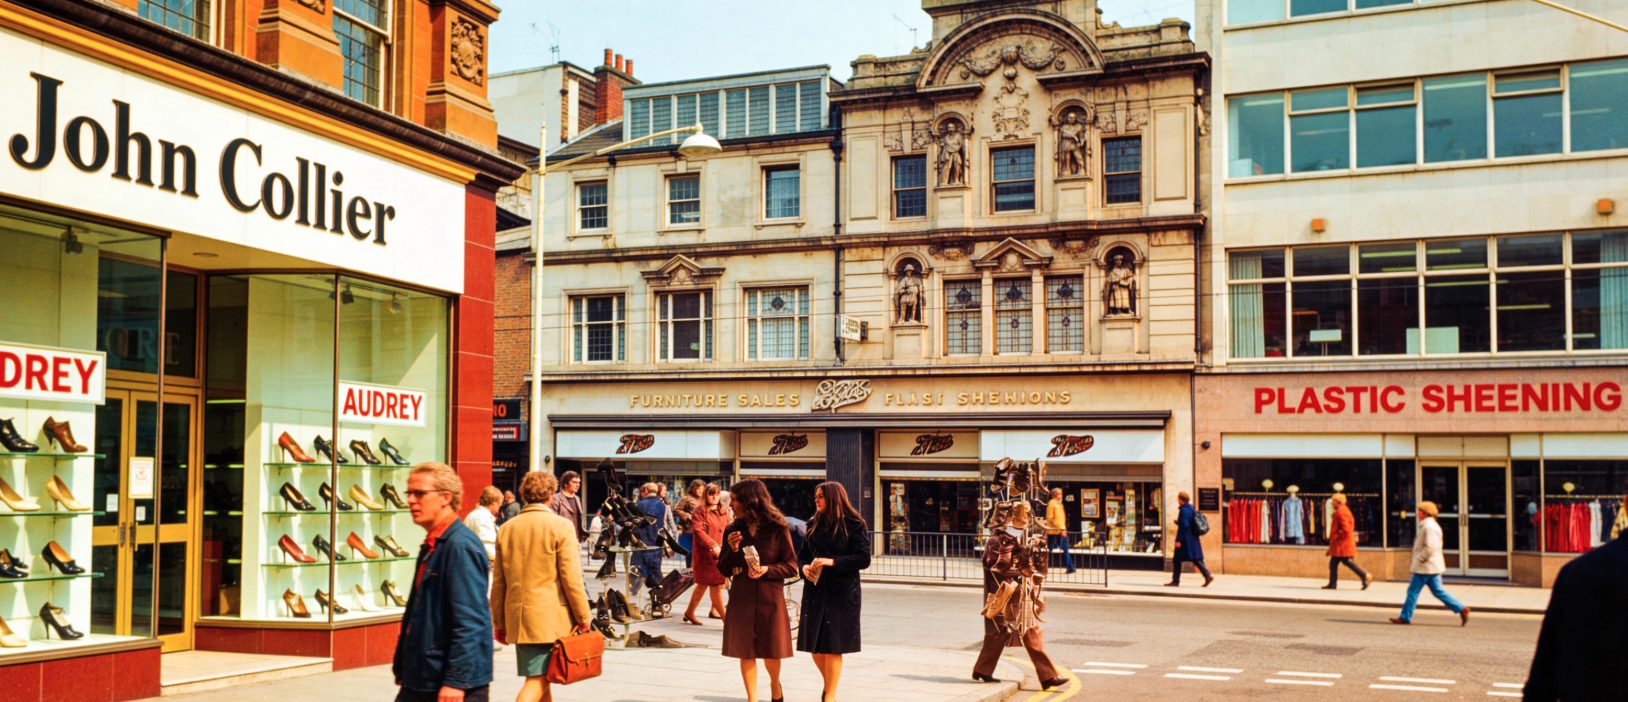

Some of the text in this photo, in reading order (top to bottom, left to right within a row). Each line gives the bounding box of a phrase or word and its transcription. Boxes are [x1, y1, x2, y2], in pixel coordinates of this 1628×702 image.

[9, 71, 396, 246] John Collier
[0, 351, 97, 394] DREY
[342, 388, 423, 421] AUDREY
[629, 393, 729, 408] FURNITURE
[738, 393, 801, 408] SALES
[1254, 380, 1623, 415] PLASTIC SHEENING
